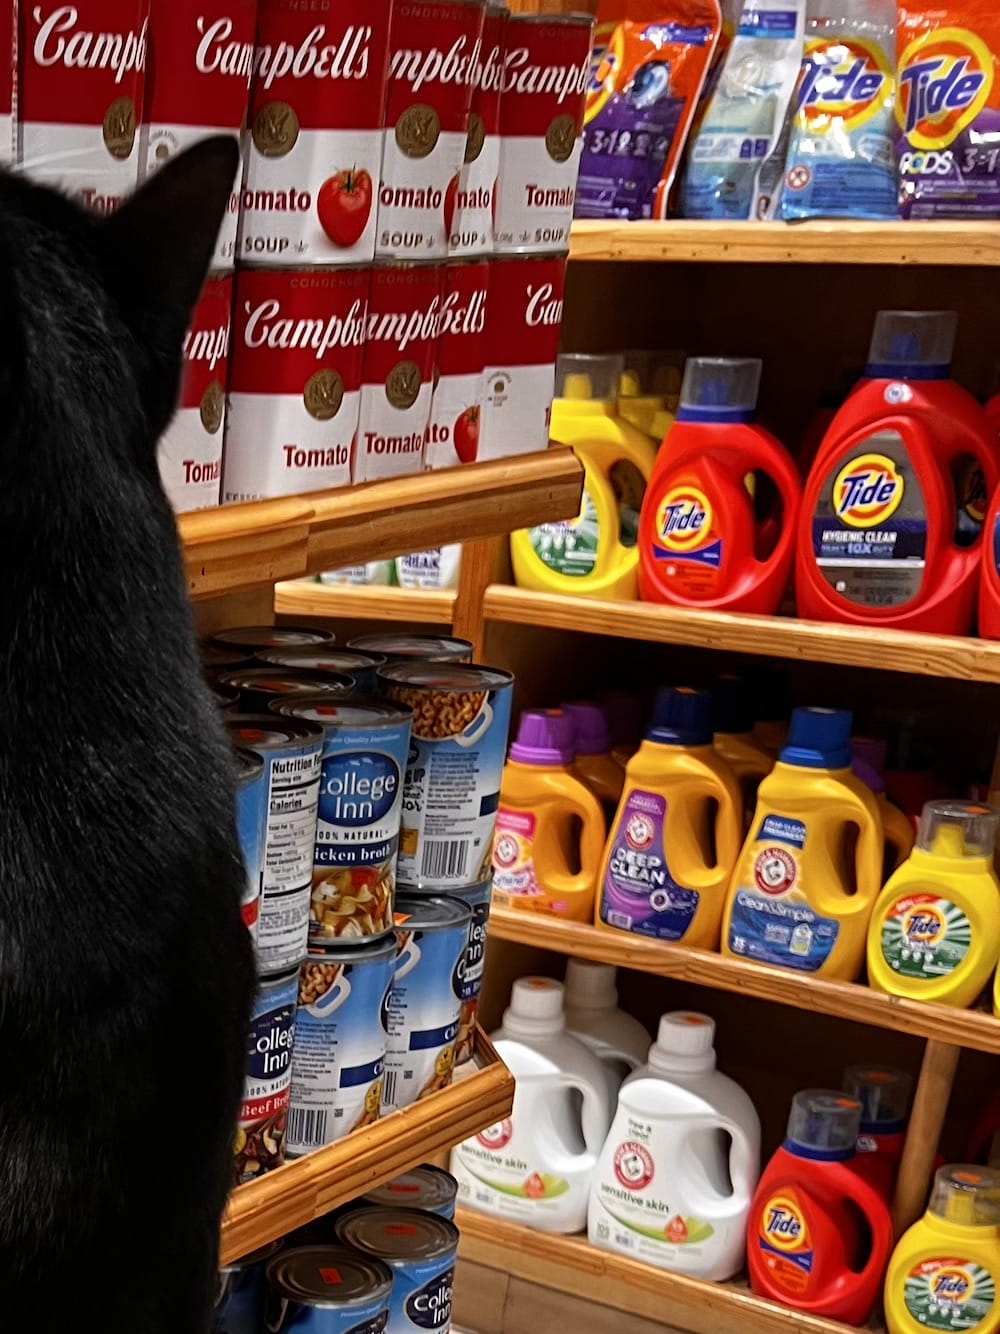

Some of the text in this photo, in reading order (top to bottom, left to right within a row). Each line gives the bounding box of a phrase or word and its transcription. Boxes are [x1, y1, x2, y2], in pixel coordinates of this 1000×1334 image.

[901, 55, 985, 138] Tide
[245, 238, 289, 253] SOUP
[381, 231, 423, 247] SOUP
[364, 431, 421, 455] Tomato
[283, 444, 348, 468] Tomato
[840, 472, 896, 515] Tide
[660, 500, 706, 539] Tide
[822, 530, 897, 543] HYGIENIC CLEAN
[271, 758, 311, 775] Nutrition
[270, 801, 302, 811] Calories
[335, 798, 373, 819] Inn
[344, 830, 383, 842] NATURAL
[615, 846, 662, 869] DEEP
[609, 857, 666, 886] CLEAN
[909, 915, 942, 938] Tide
[601, 1181, 670, 1214] sensitive skin
[766, 1206, 804, 1238] Tide
[931, 1274, 969, 1298] Tide
